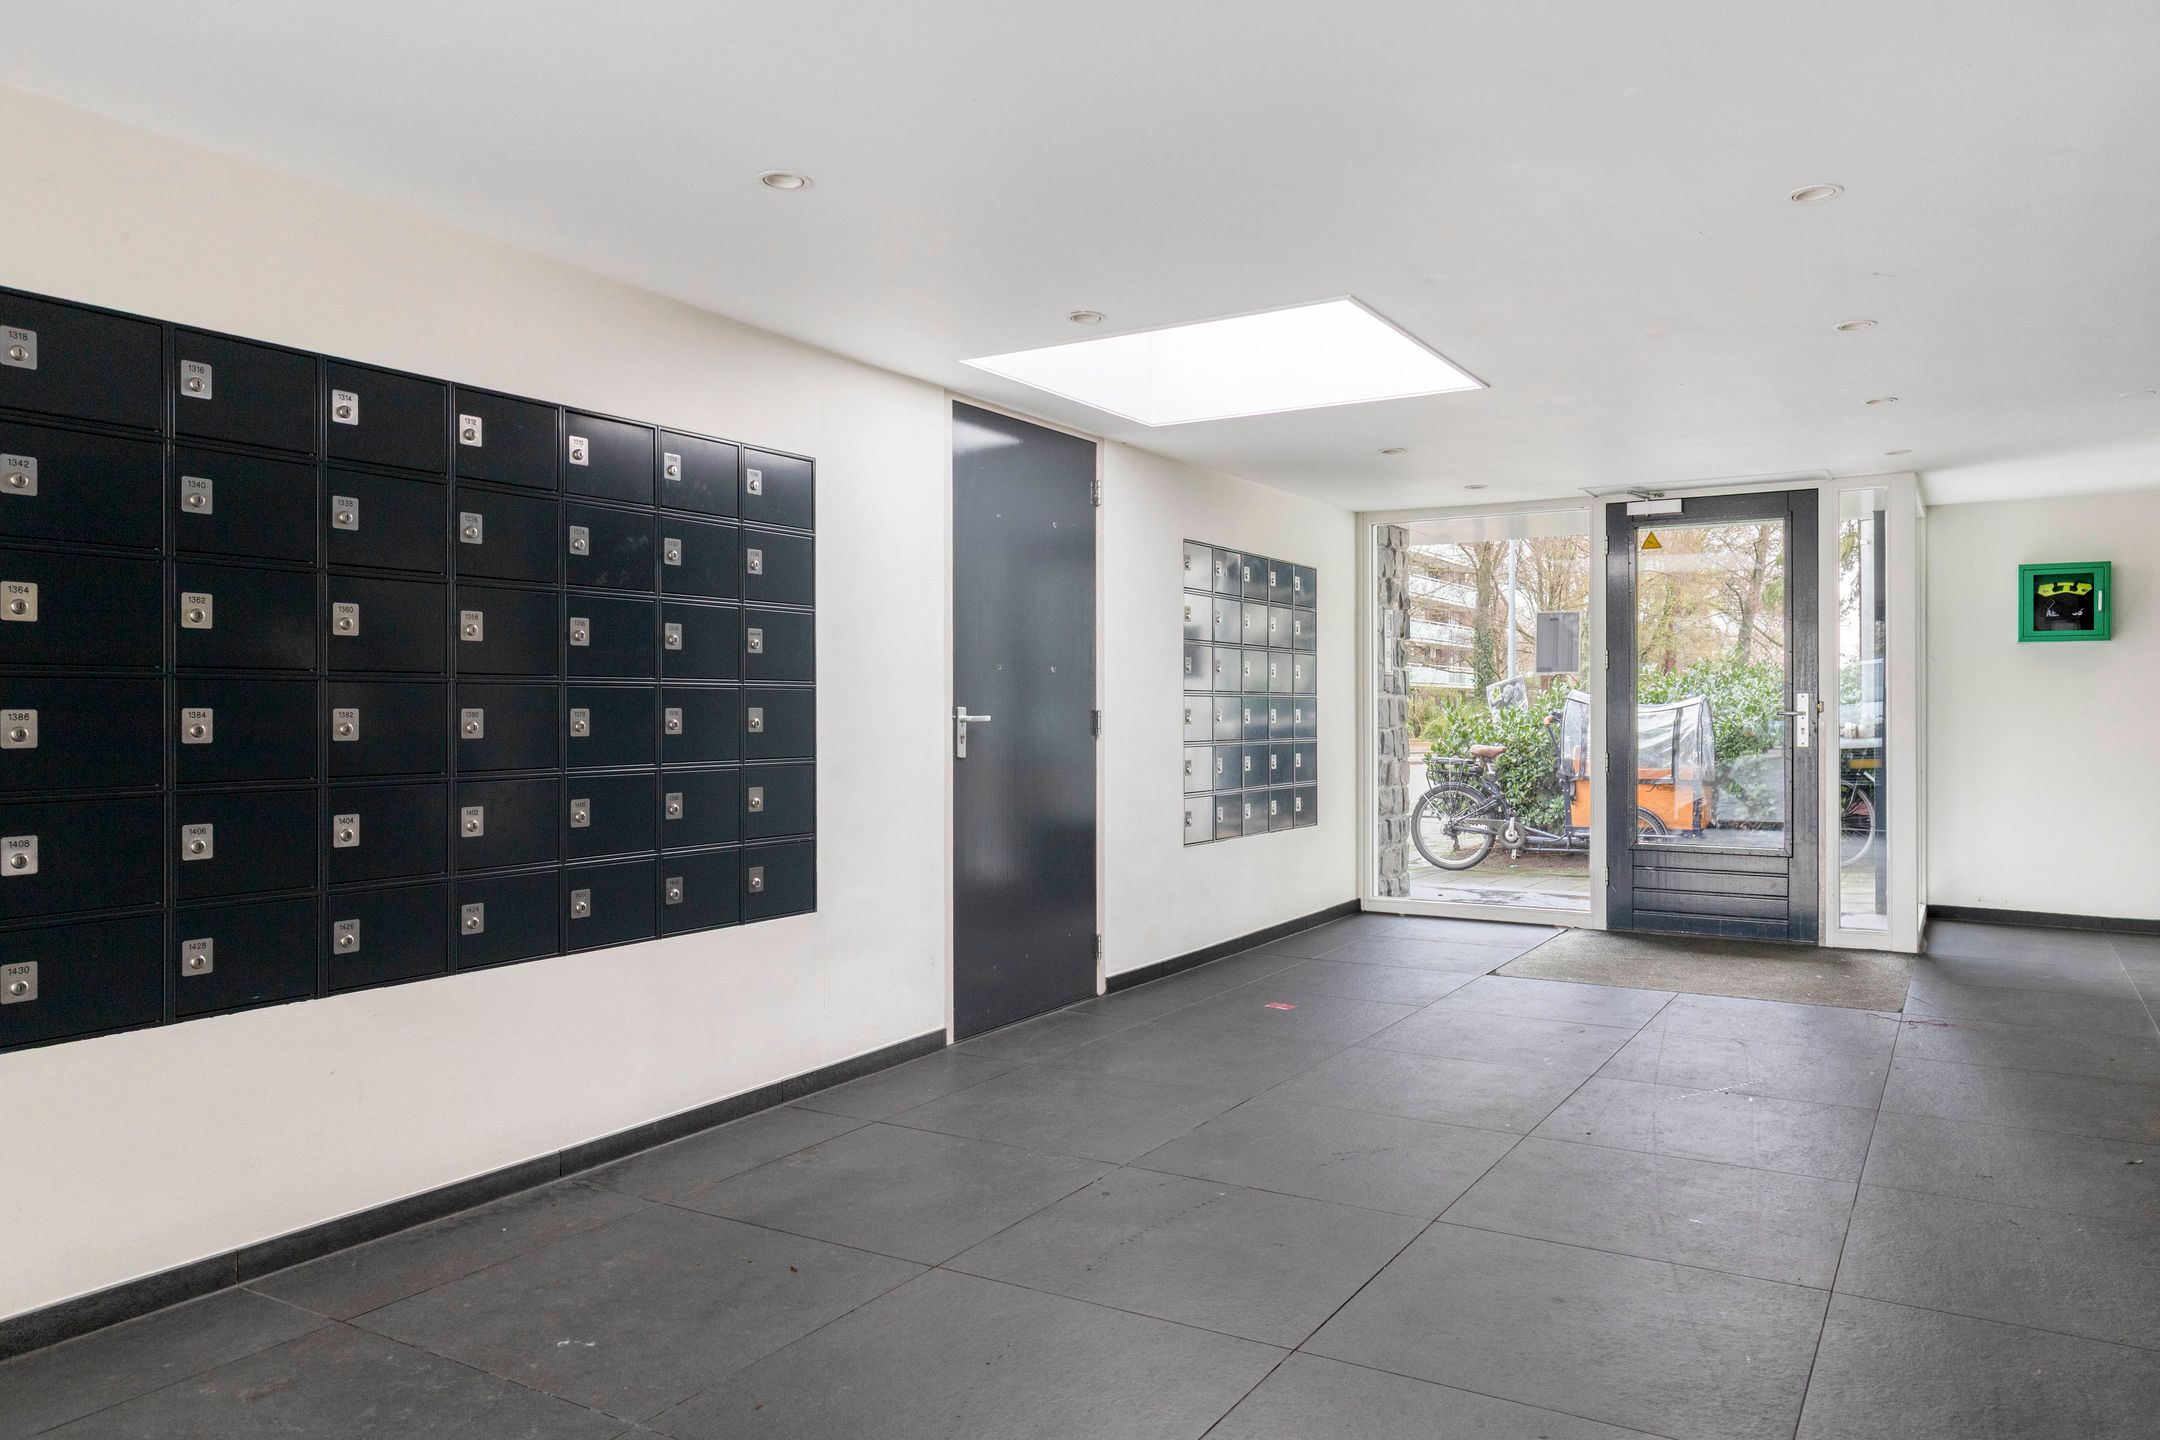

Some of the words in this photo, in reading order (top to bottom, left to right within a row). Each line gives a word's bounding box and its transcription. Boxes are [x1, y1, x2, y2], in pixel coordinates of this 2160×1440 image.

[9, 331, 28, 341] 1318
[189, 365, 204, 374] 1316
[338, 394, 351, 402] 1314
[8, 459, 30, 468] 1342
[188, 481, 206, 489] 1340
[9, 586, 30, 594] 1364
[188, 596, 205, 604] 1362
[8, 713, 30, 721] 1386
[9, 840, 30, 848] 1408
[189, 942, 206, 950] 1428
[9, 966, 30, 975] 1430
